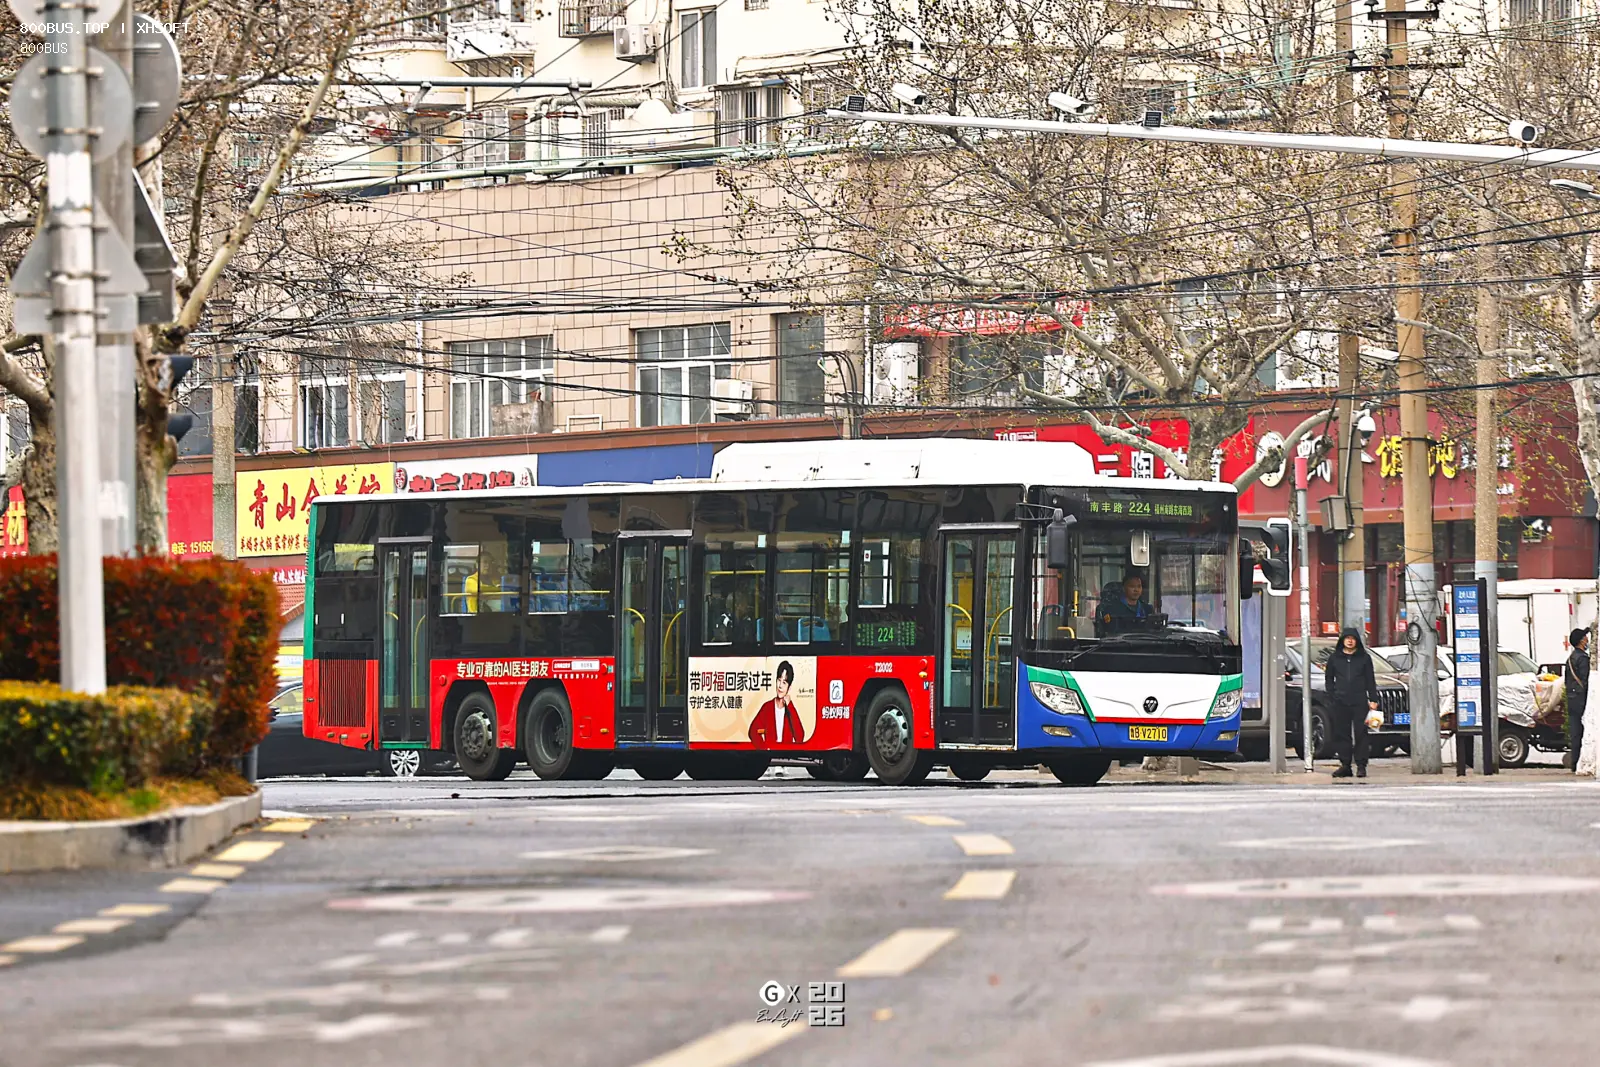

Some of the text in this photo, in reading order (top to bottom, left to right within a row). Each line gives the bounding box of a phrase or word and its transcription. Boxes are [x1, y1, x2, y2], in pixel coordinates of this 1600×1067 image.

[1089, 501, 1123, 513] 南丰路
[1128, 501, 1151, 513] 224
[877, 627, 895, 642] 224
[456, 660, 549, 678] 专业可靠的AI医生朋友
[874, 661, 893, 673] T2002
[689, 670, 772, 692] 带阿福回家过年
[689, 695, 743, 710] 守护全家人健康
[821, 706, 850, 719] 蚂蚁阿福
